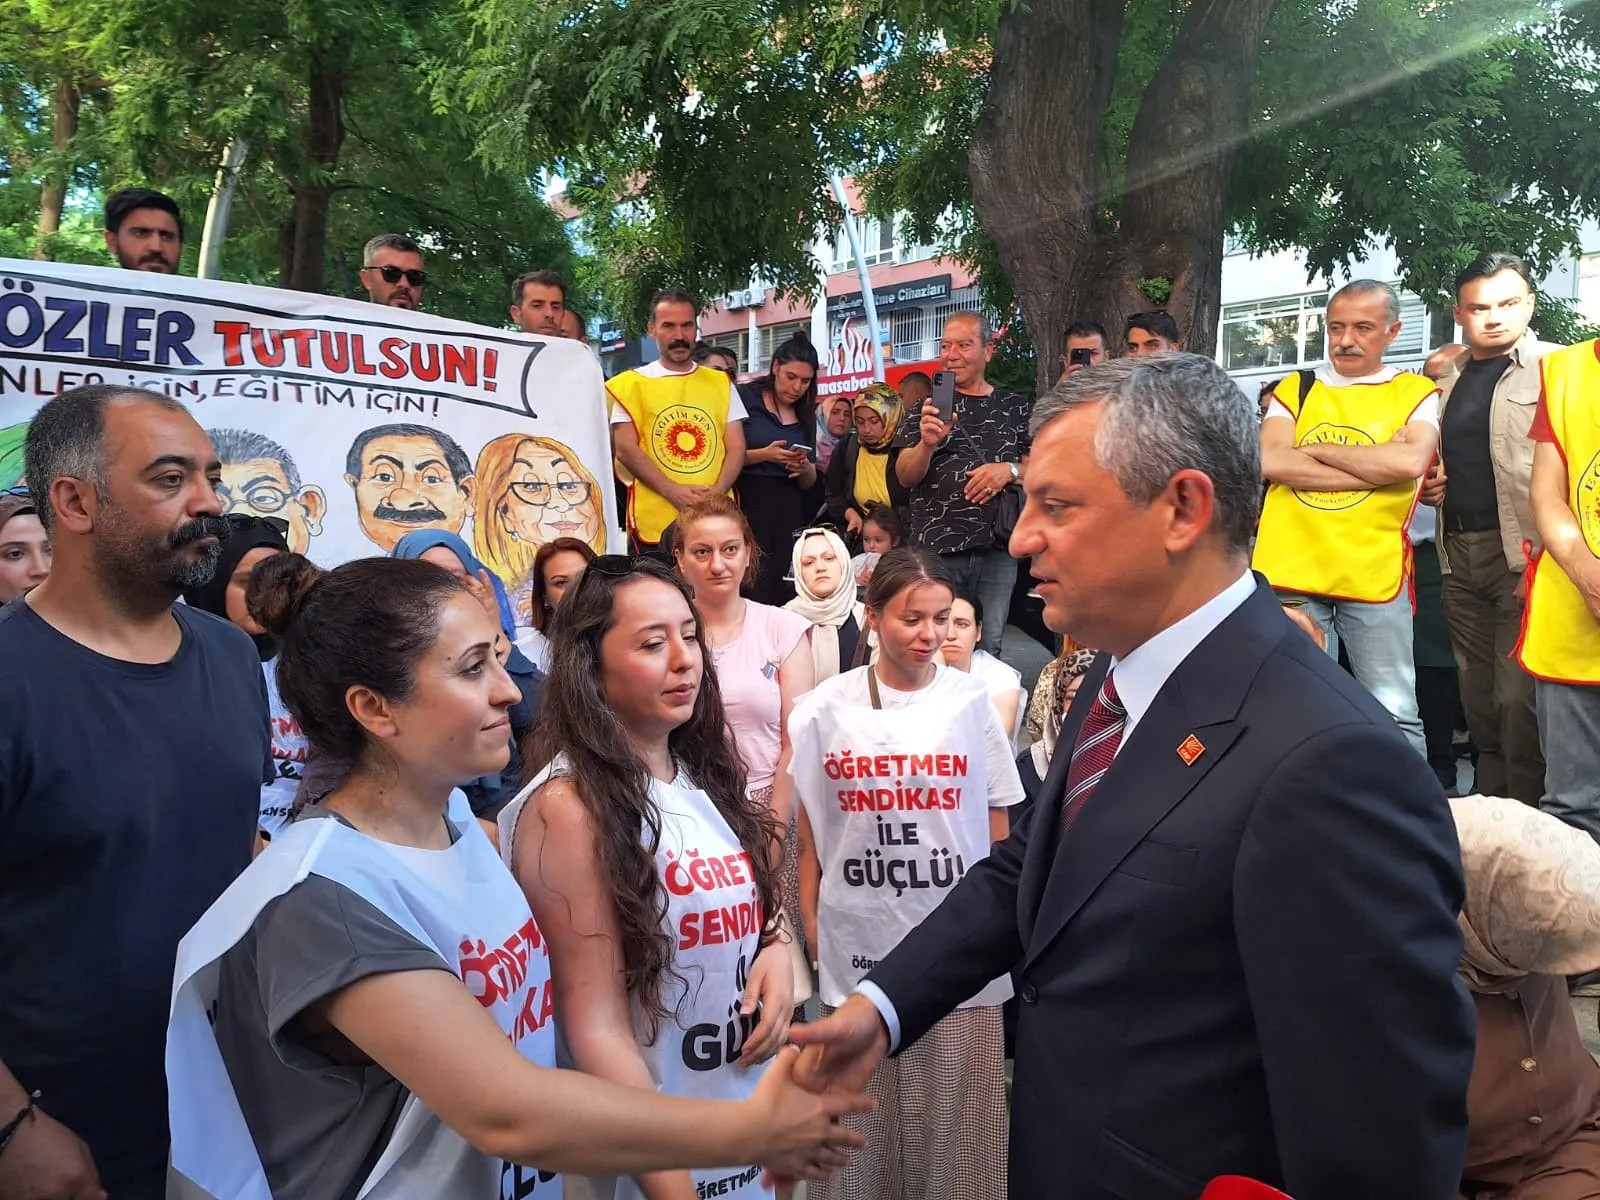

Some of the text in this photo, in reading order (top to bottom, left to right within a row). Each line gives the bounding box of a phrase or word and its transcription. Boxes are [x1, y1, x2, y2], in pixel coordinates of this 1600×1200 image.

[898, 283, 946, 301] Cihazları
[0, 278, 499, 392] ÖZLER TUTULSUN!
[824, 750, 968, 780] ÖĞRETMEN
[837, 780, 962, 812] SENDİKASI
[876, 815, 920, 846] İLE
[843, 847, 964, 898] GÜÇLÜ!
